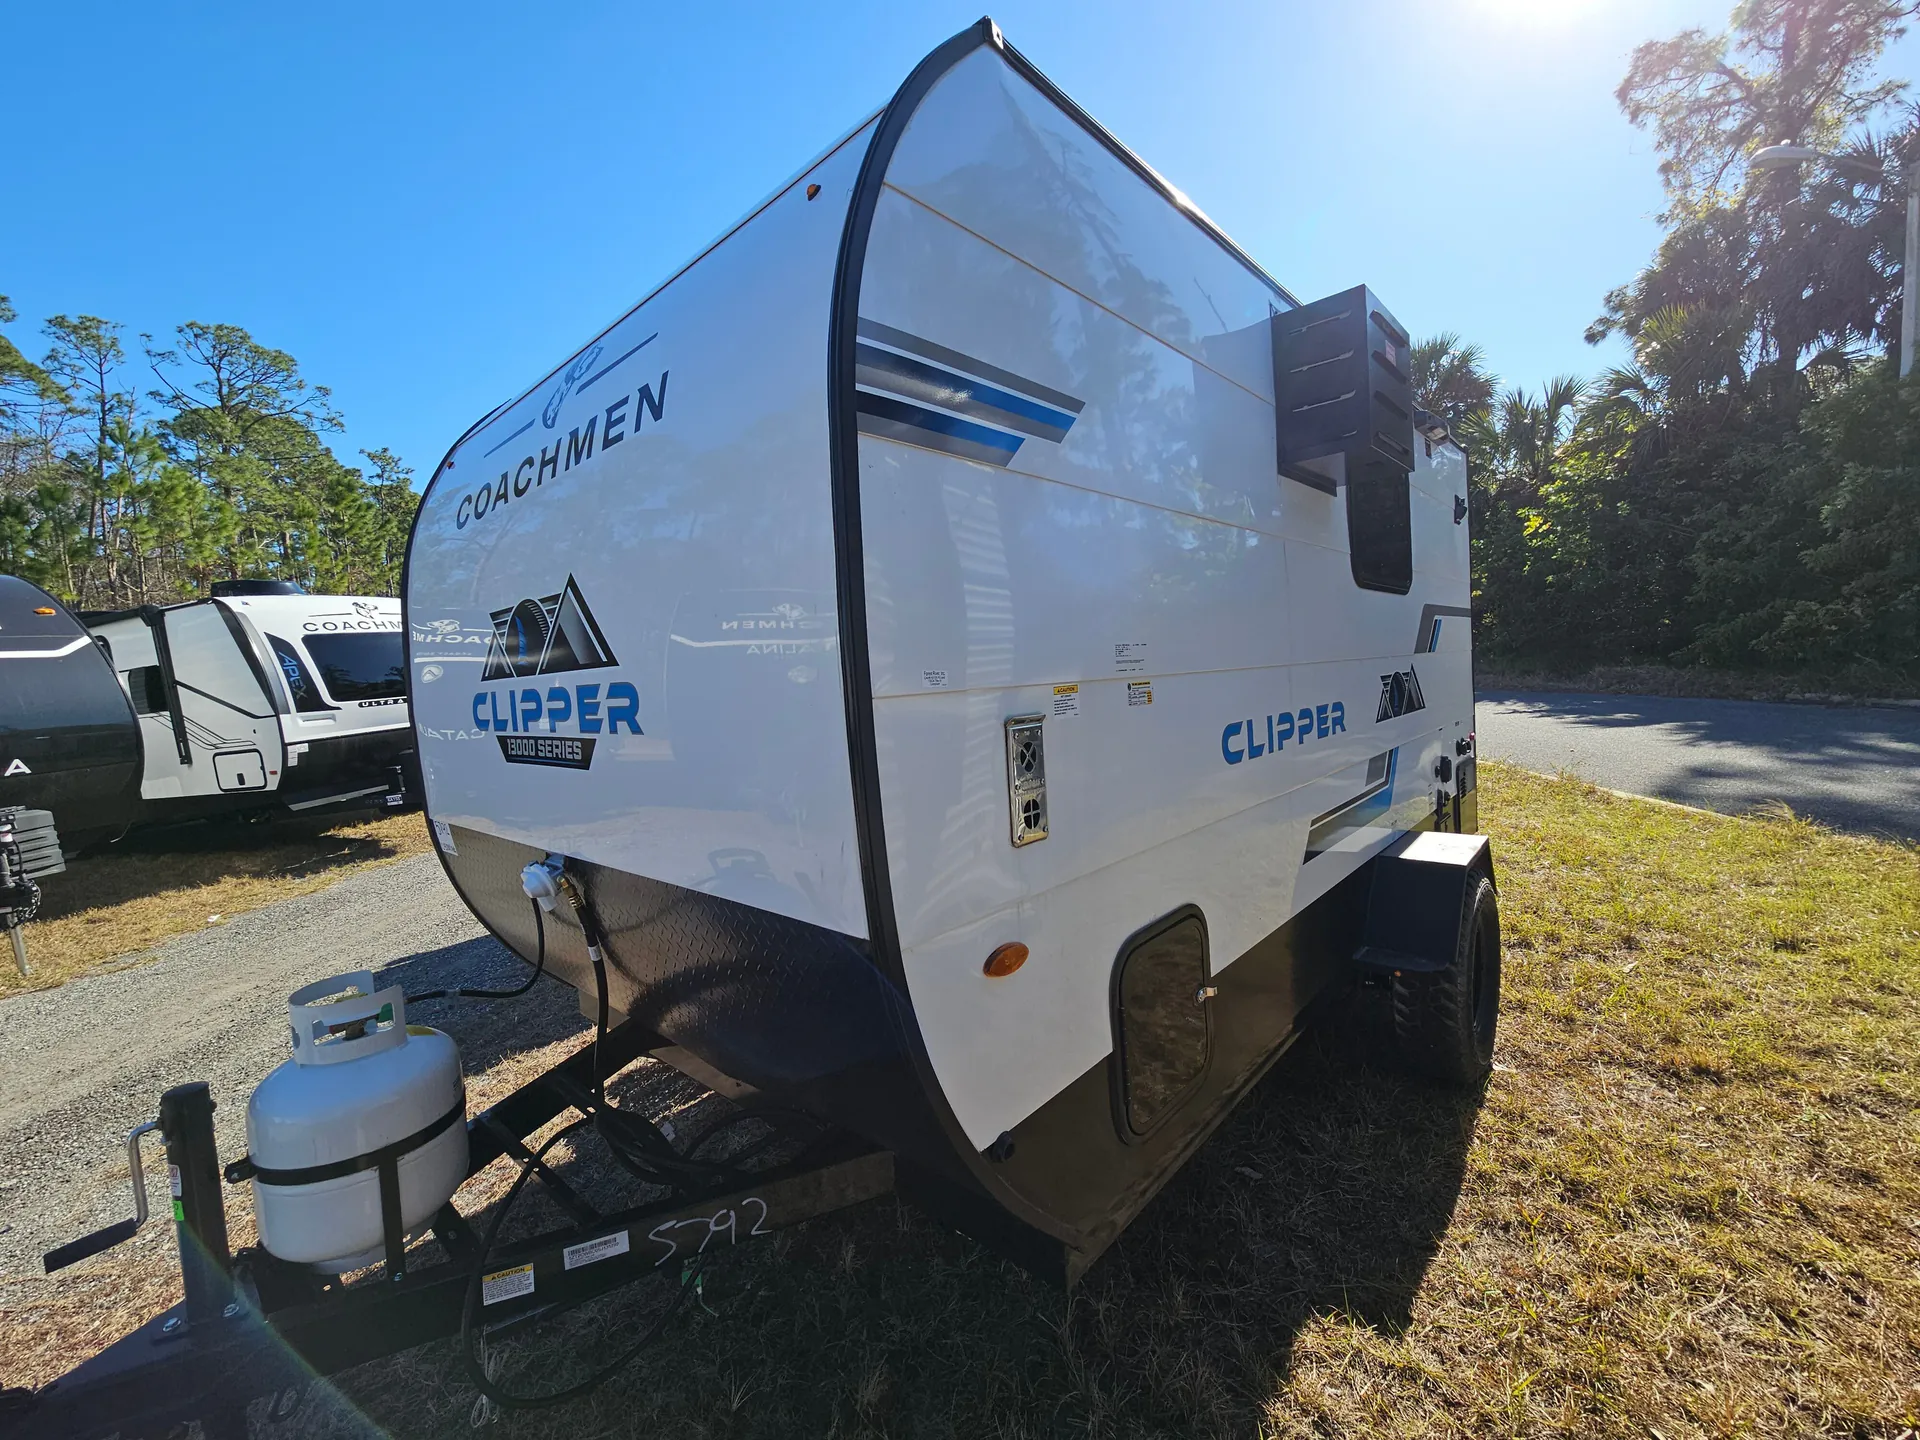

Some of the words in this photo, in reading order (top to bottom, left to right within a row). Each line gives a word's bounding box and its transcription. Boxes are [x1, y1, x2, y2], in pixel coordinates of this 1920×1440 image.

[456, 370, 669, 530] COACHMEN
[278, 651, 308, 700] APEX
[362, 698, 404, 707] ULTRA
[472, 682, 644, 735] CLIPPER
[507, 738, 535, 756] 13000
[538, 740, 582, 760] SERIES
[1221, 701, 1346, 765] CLIPPER
[648, 1197, 773, 1267] 5792
[496, 1267, 525, 1279] CAUTION
